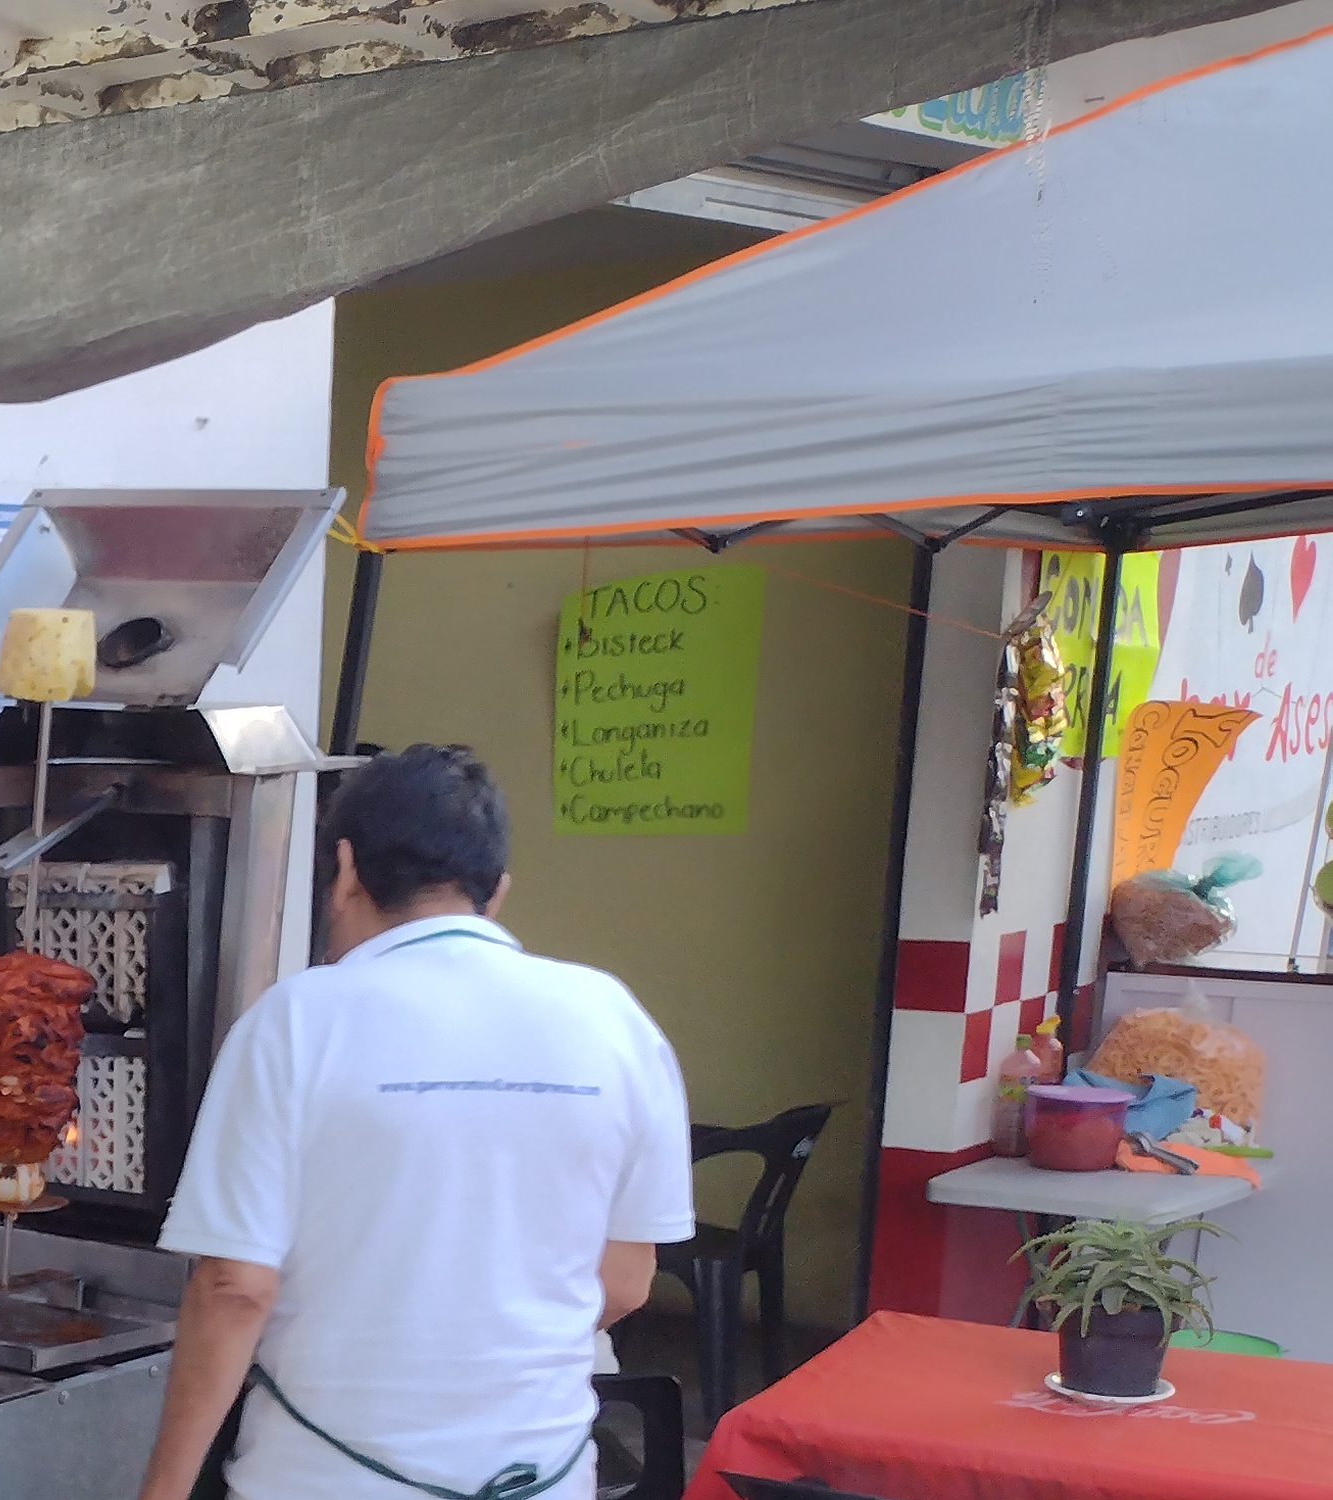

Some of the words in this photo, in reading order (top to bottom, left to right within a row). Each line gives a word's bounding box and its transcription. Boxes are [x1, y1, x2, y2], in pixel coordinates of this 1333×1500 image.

[1254, 630, 1278, 679] de
[573, 668, 686, 713] Pechuga
[571, 717, 710, 756] Longaniza
